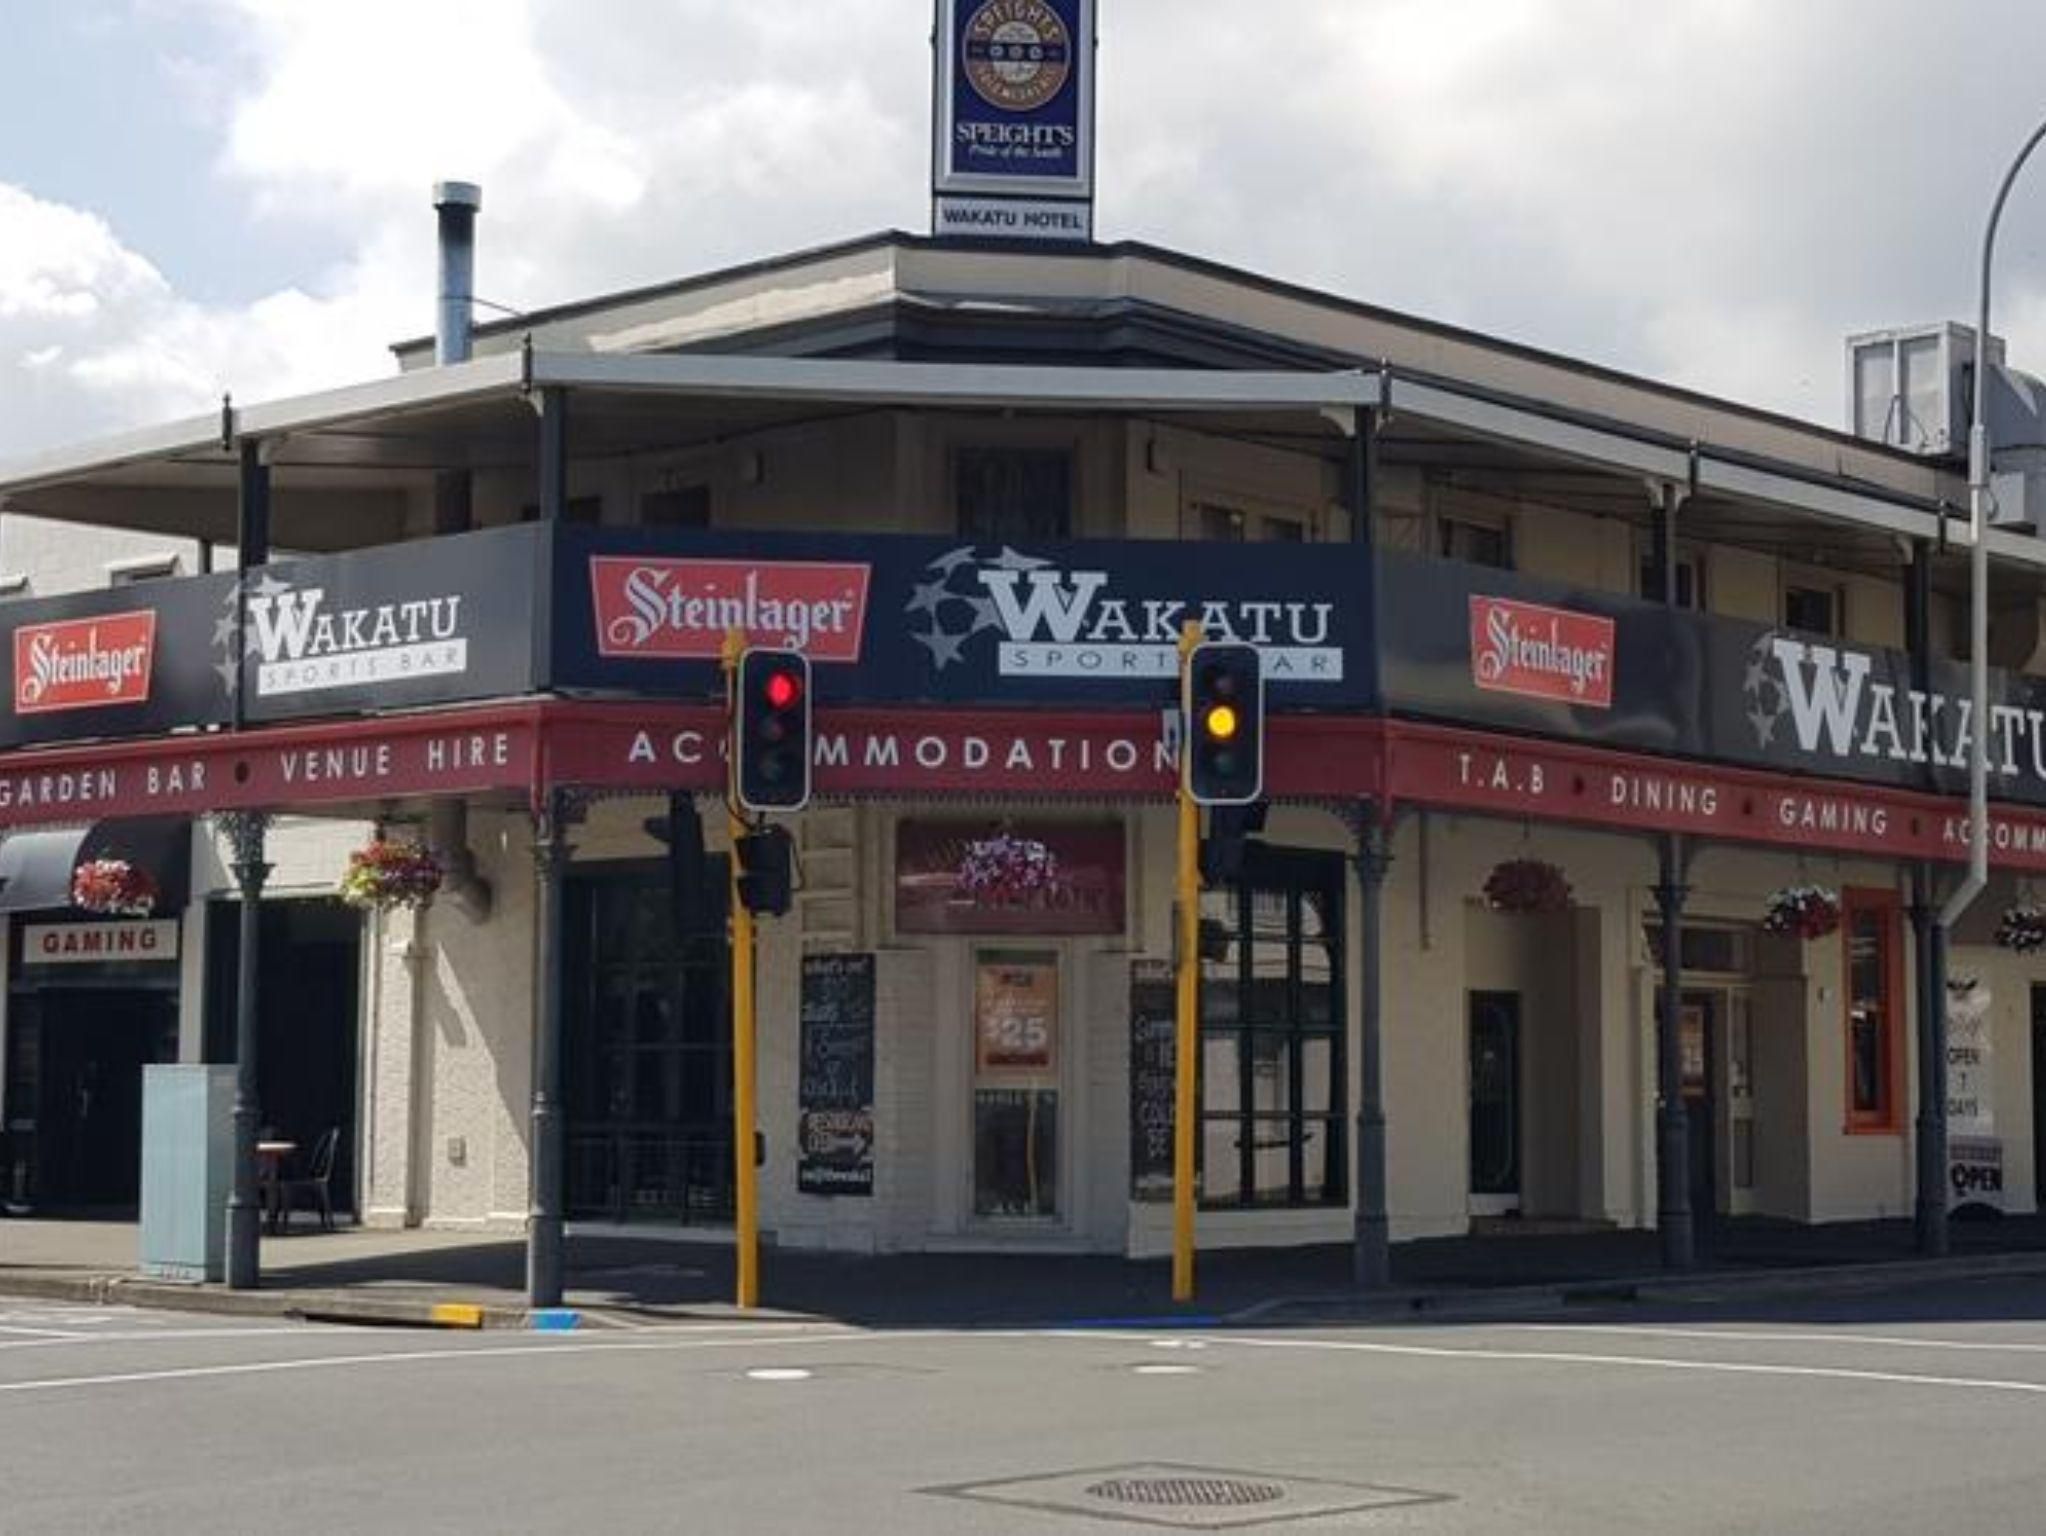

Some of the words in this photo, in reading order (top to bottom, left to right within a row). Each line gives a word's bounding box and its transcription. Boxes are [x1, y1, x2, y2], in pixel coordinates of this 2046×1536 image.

[944, 209, 1016, 227] WAKATU
[1024, 211, 1083, 229] HOTEL
[249, 588, 461, 661] WAKATU
[607, 567, 854, 651] Steinlager
[978, 570, 1333, 643] WAKATU
[22, 624, 147, 702] Steinlager
[400, 645, 458, 671] BAR
[1013, 651, 1166, 669] SPORT
[1272, 654, 1328, 673] AR
[1479, 603, 1606, 694] Steinlager
[280, 745, 390, 783] VENUE
[426, 733, 508, 771] HIRE
[628, 730, 1181, 771] ACMMODATION
[0, 769, 117, 808] GARDEN
[147, 762, 206, 794] BAR
[1612, 776, 1717, 816] DINING
[1779, 798, 1887, 834] GAMING
[42, 927, 157, 953] GAMING
